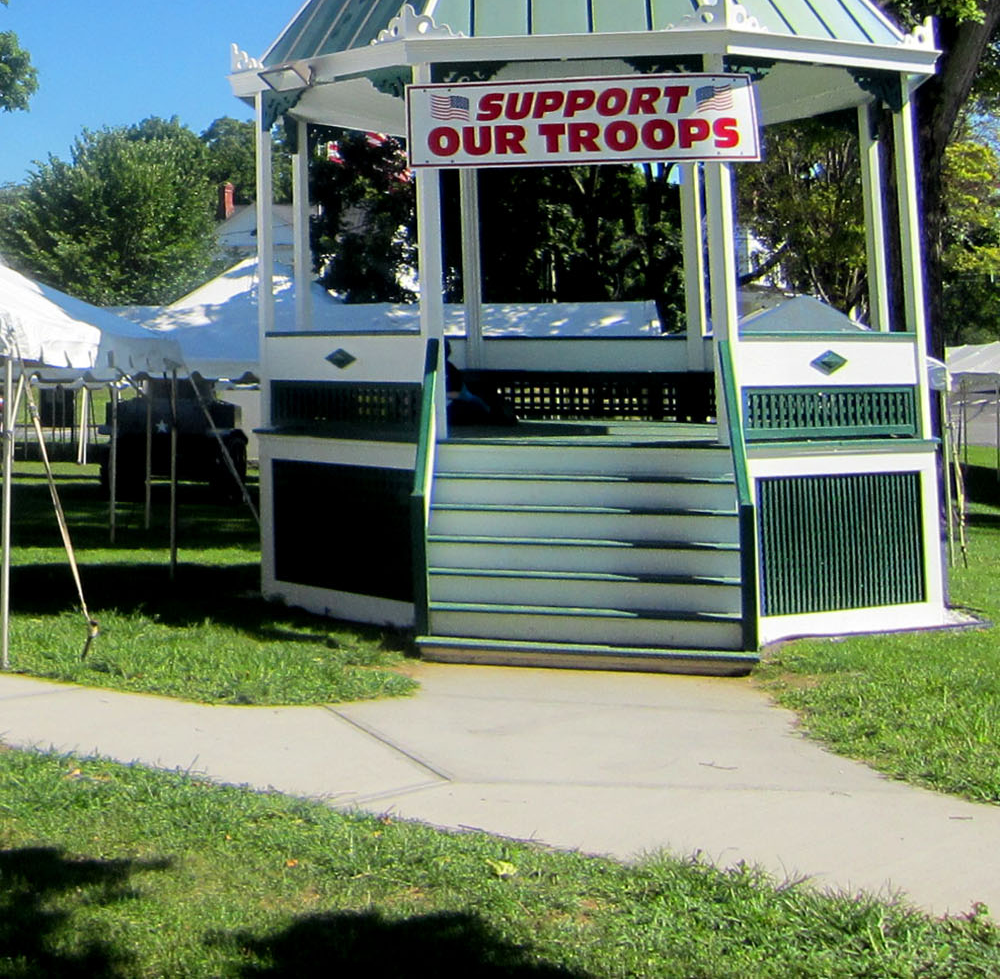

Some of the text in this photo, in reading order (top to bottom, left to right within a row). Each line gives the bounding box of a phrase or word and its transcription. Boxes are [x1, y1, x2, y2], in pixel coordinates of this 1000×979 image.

[475, 85, 690, 121] SUPPORT
[427, 117, 740, 157] OUR TROOPS
